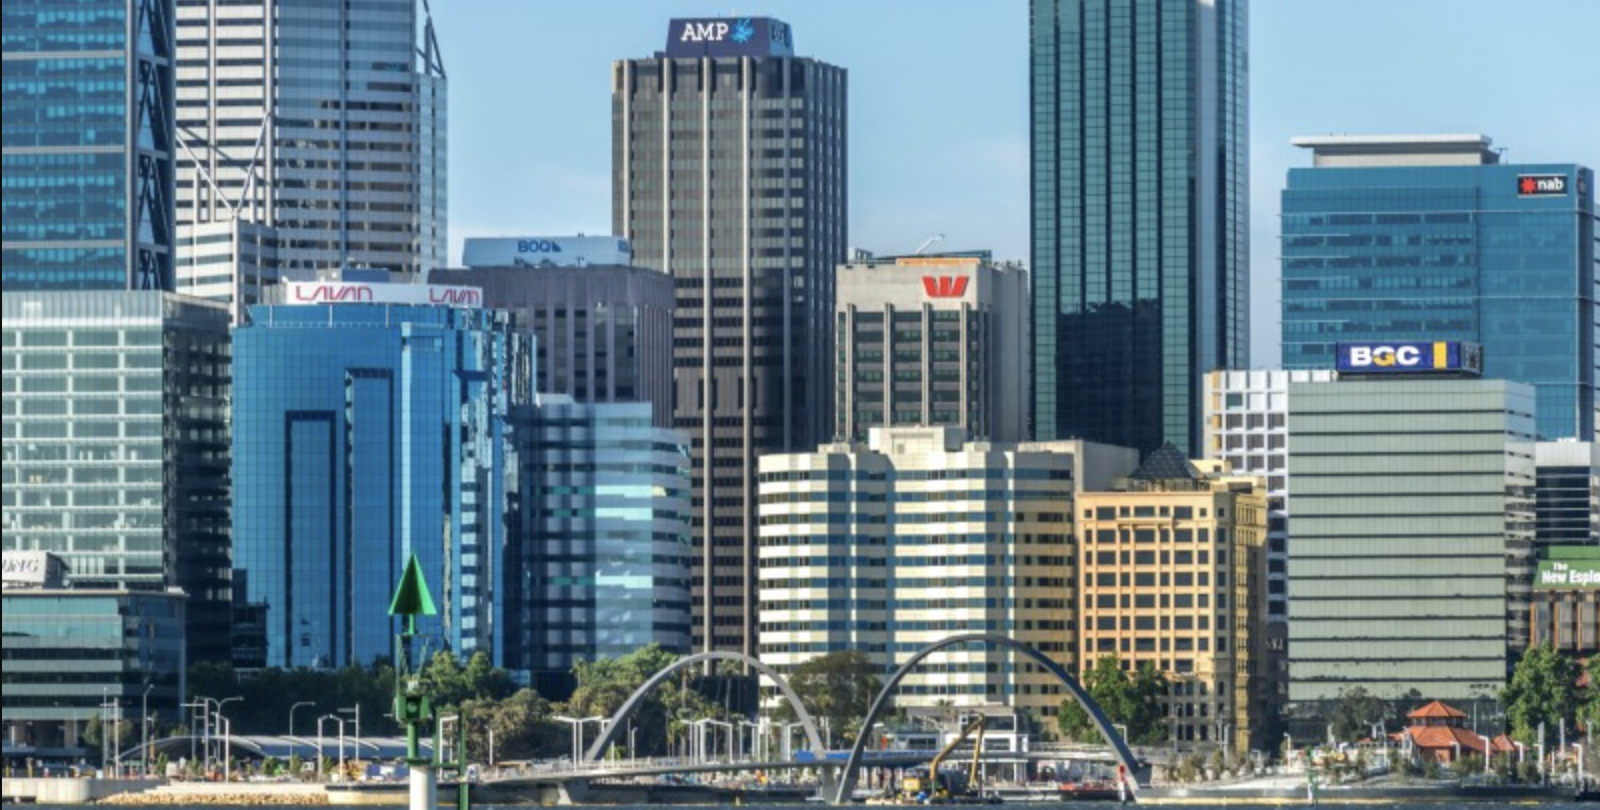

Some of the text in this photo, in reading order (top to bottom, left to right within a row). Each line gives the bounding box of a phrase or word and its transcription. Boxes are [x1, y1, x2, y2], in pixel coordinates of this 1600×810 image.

[681, 22, 729, 42] AMP
[1537, 177, 1564, 191] nab
[517, 240, 551, 253] BOQ
[295, 284, 373, 301] LAVAN
[1350, 345, 1420, 367] BGC
[1552, 561, 1569, 571] The
[1541, 570, 1567, 584] New
